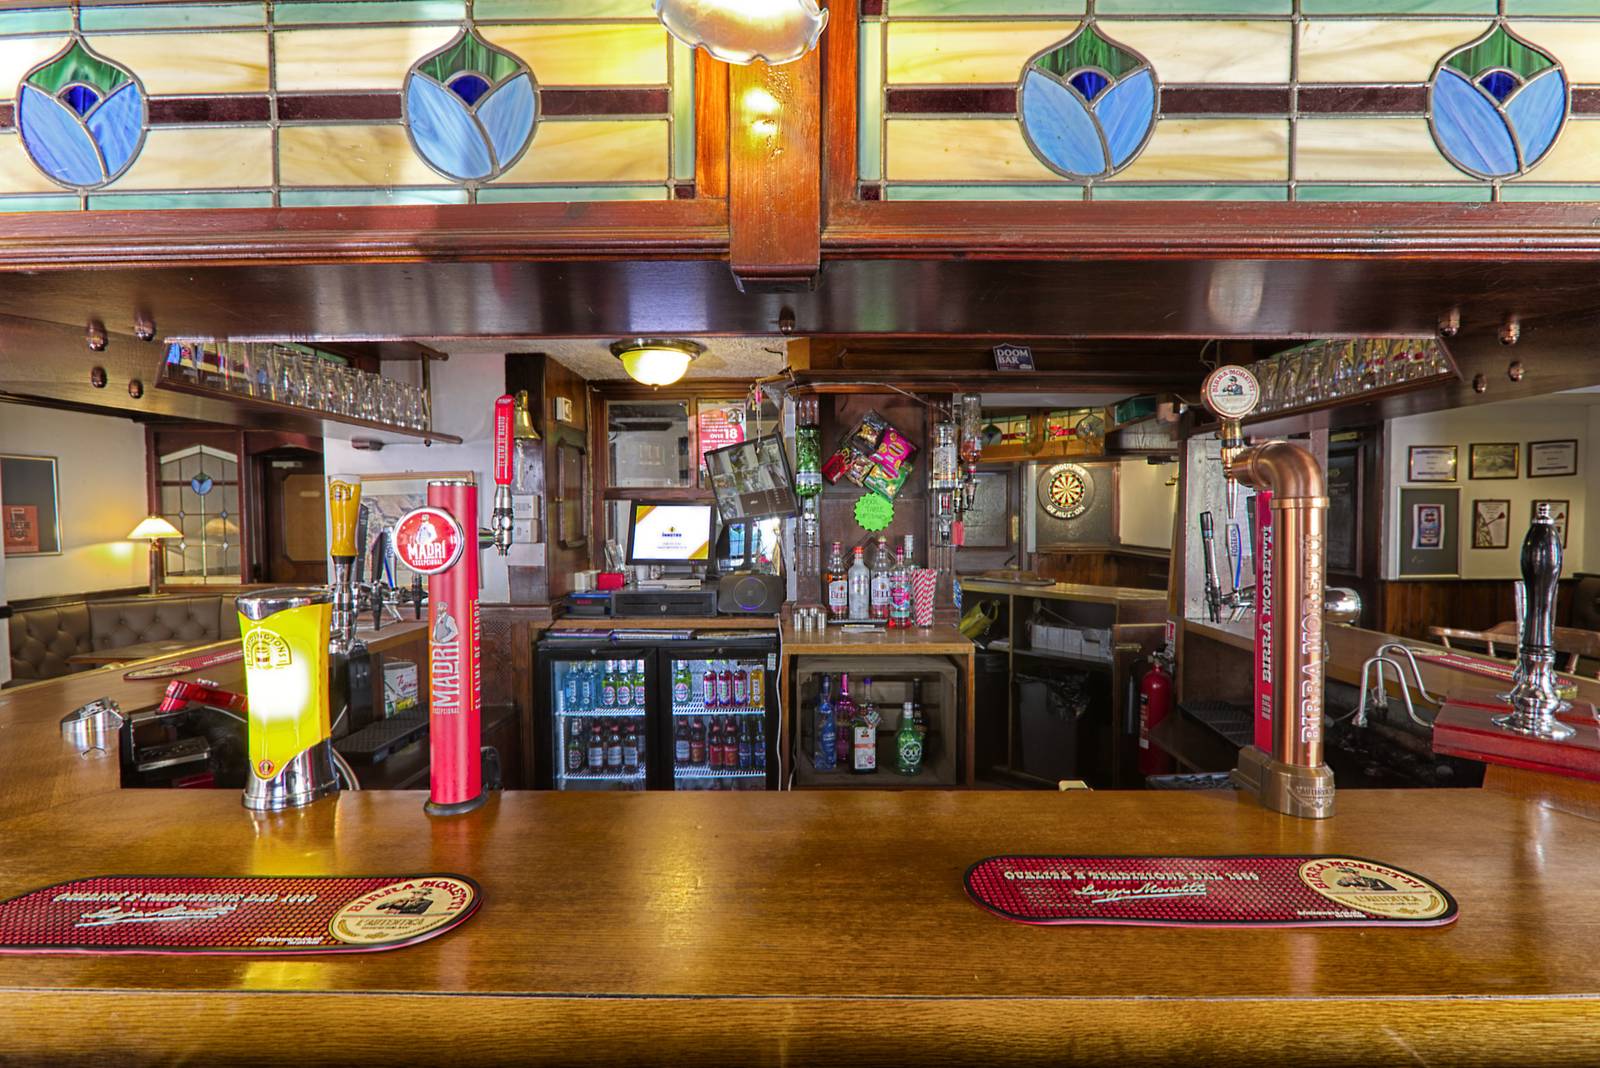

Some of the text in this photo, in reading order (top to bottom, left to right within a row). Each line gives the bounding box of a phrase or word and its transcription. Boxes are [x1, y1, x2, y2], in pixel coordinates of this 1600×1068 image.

[997, 349, 1029, 357] DOOM
[999, 356, 1020, 364] BAR
[724, 427, 738, 439] 18
[407, 540, 446, 560] MADRÍ
[1263, 526, 1272, 683] BIRRA MORETTI
[1301, 533, 1322, 743] BIRRA MORETTI
[429, 639, 460, 707] MADRÍ
[1305, 860, 1426, 890] BIRRA MORETTI
[347, 880, 468, 912] BIRRA MORETTI
